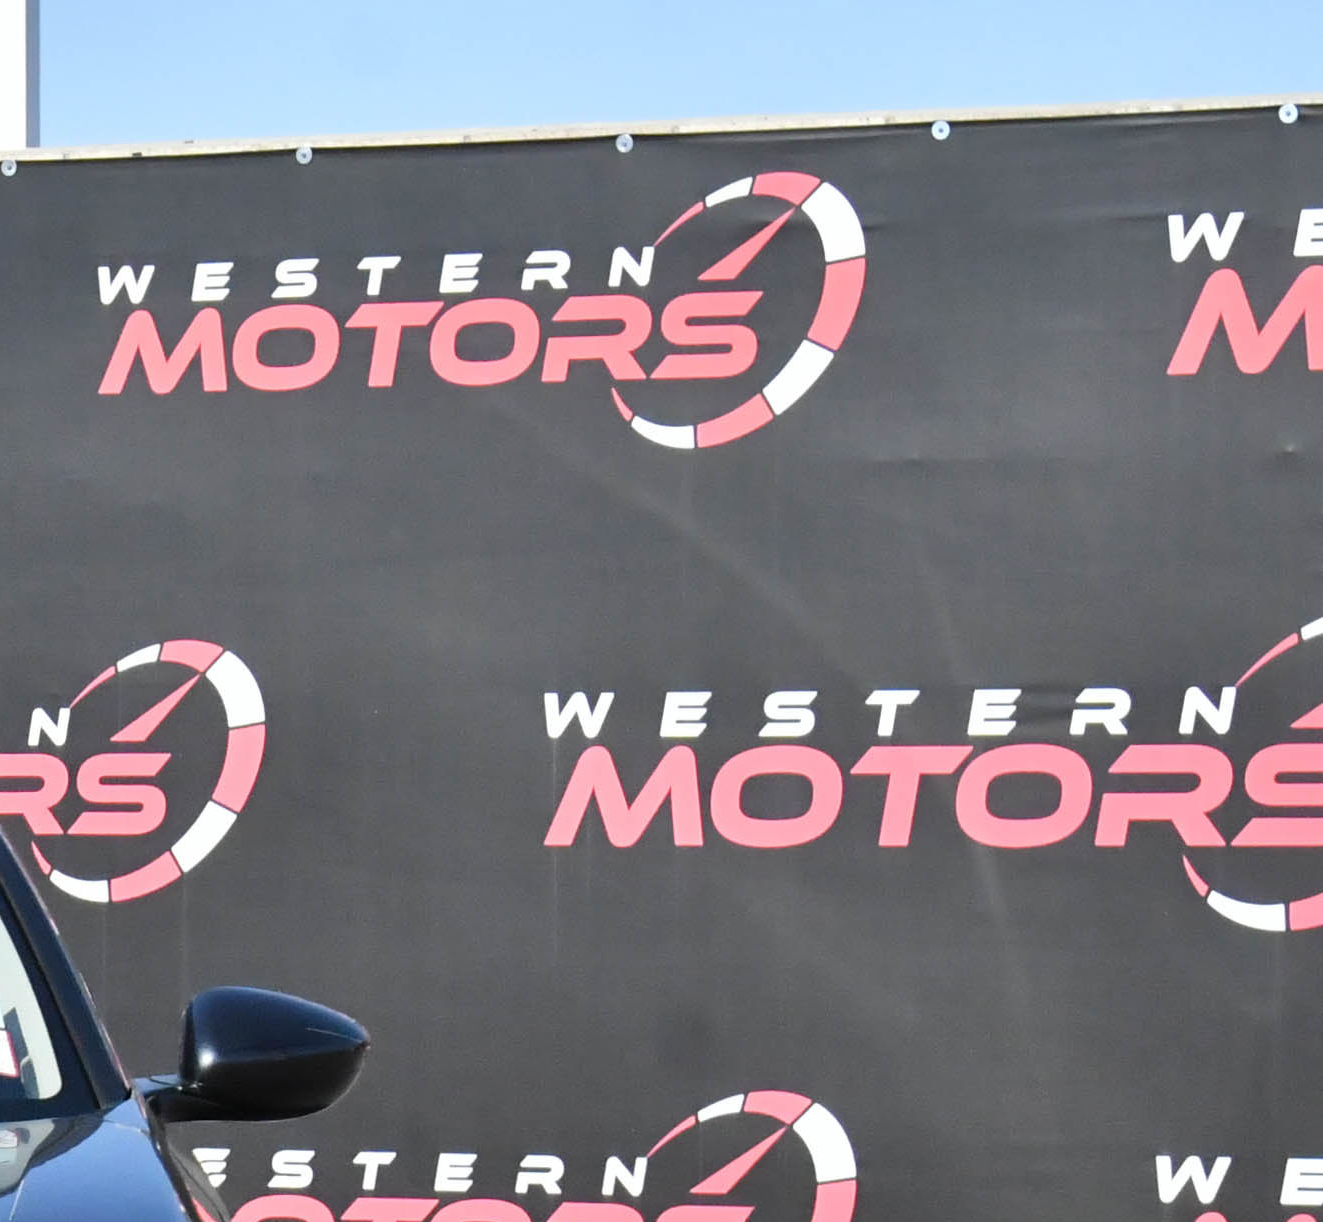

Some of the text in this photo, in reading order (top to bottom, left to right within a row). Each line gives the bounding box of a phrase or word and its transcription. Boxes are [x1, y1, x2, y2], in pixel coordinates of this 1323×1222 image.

[97, 246, 656, 304] WESTERN
[99, 290, 764, 396] MOTORS
[543, 686, 1237, 740] WESTERN
[543, 743, 1323, 850] MOTORS
